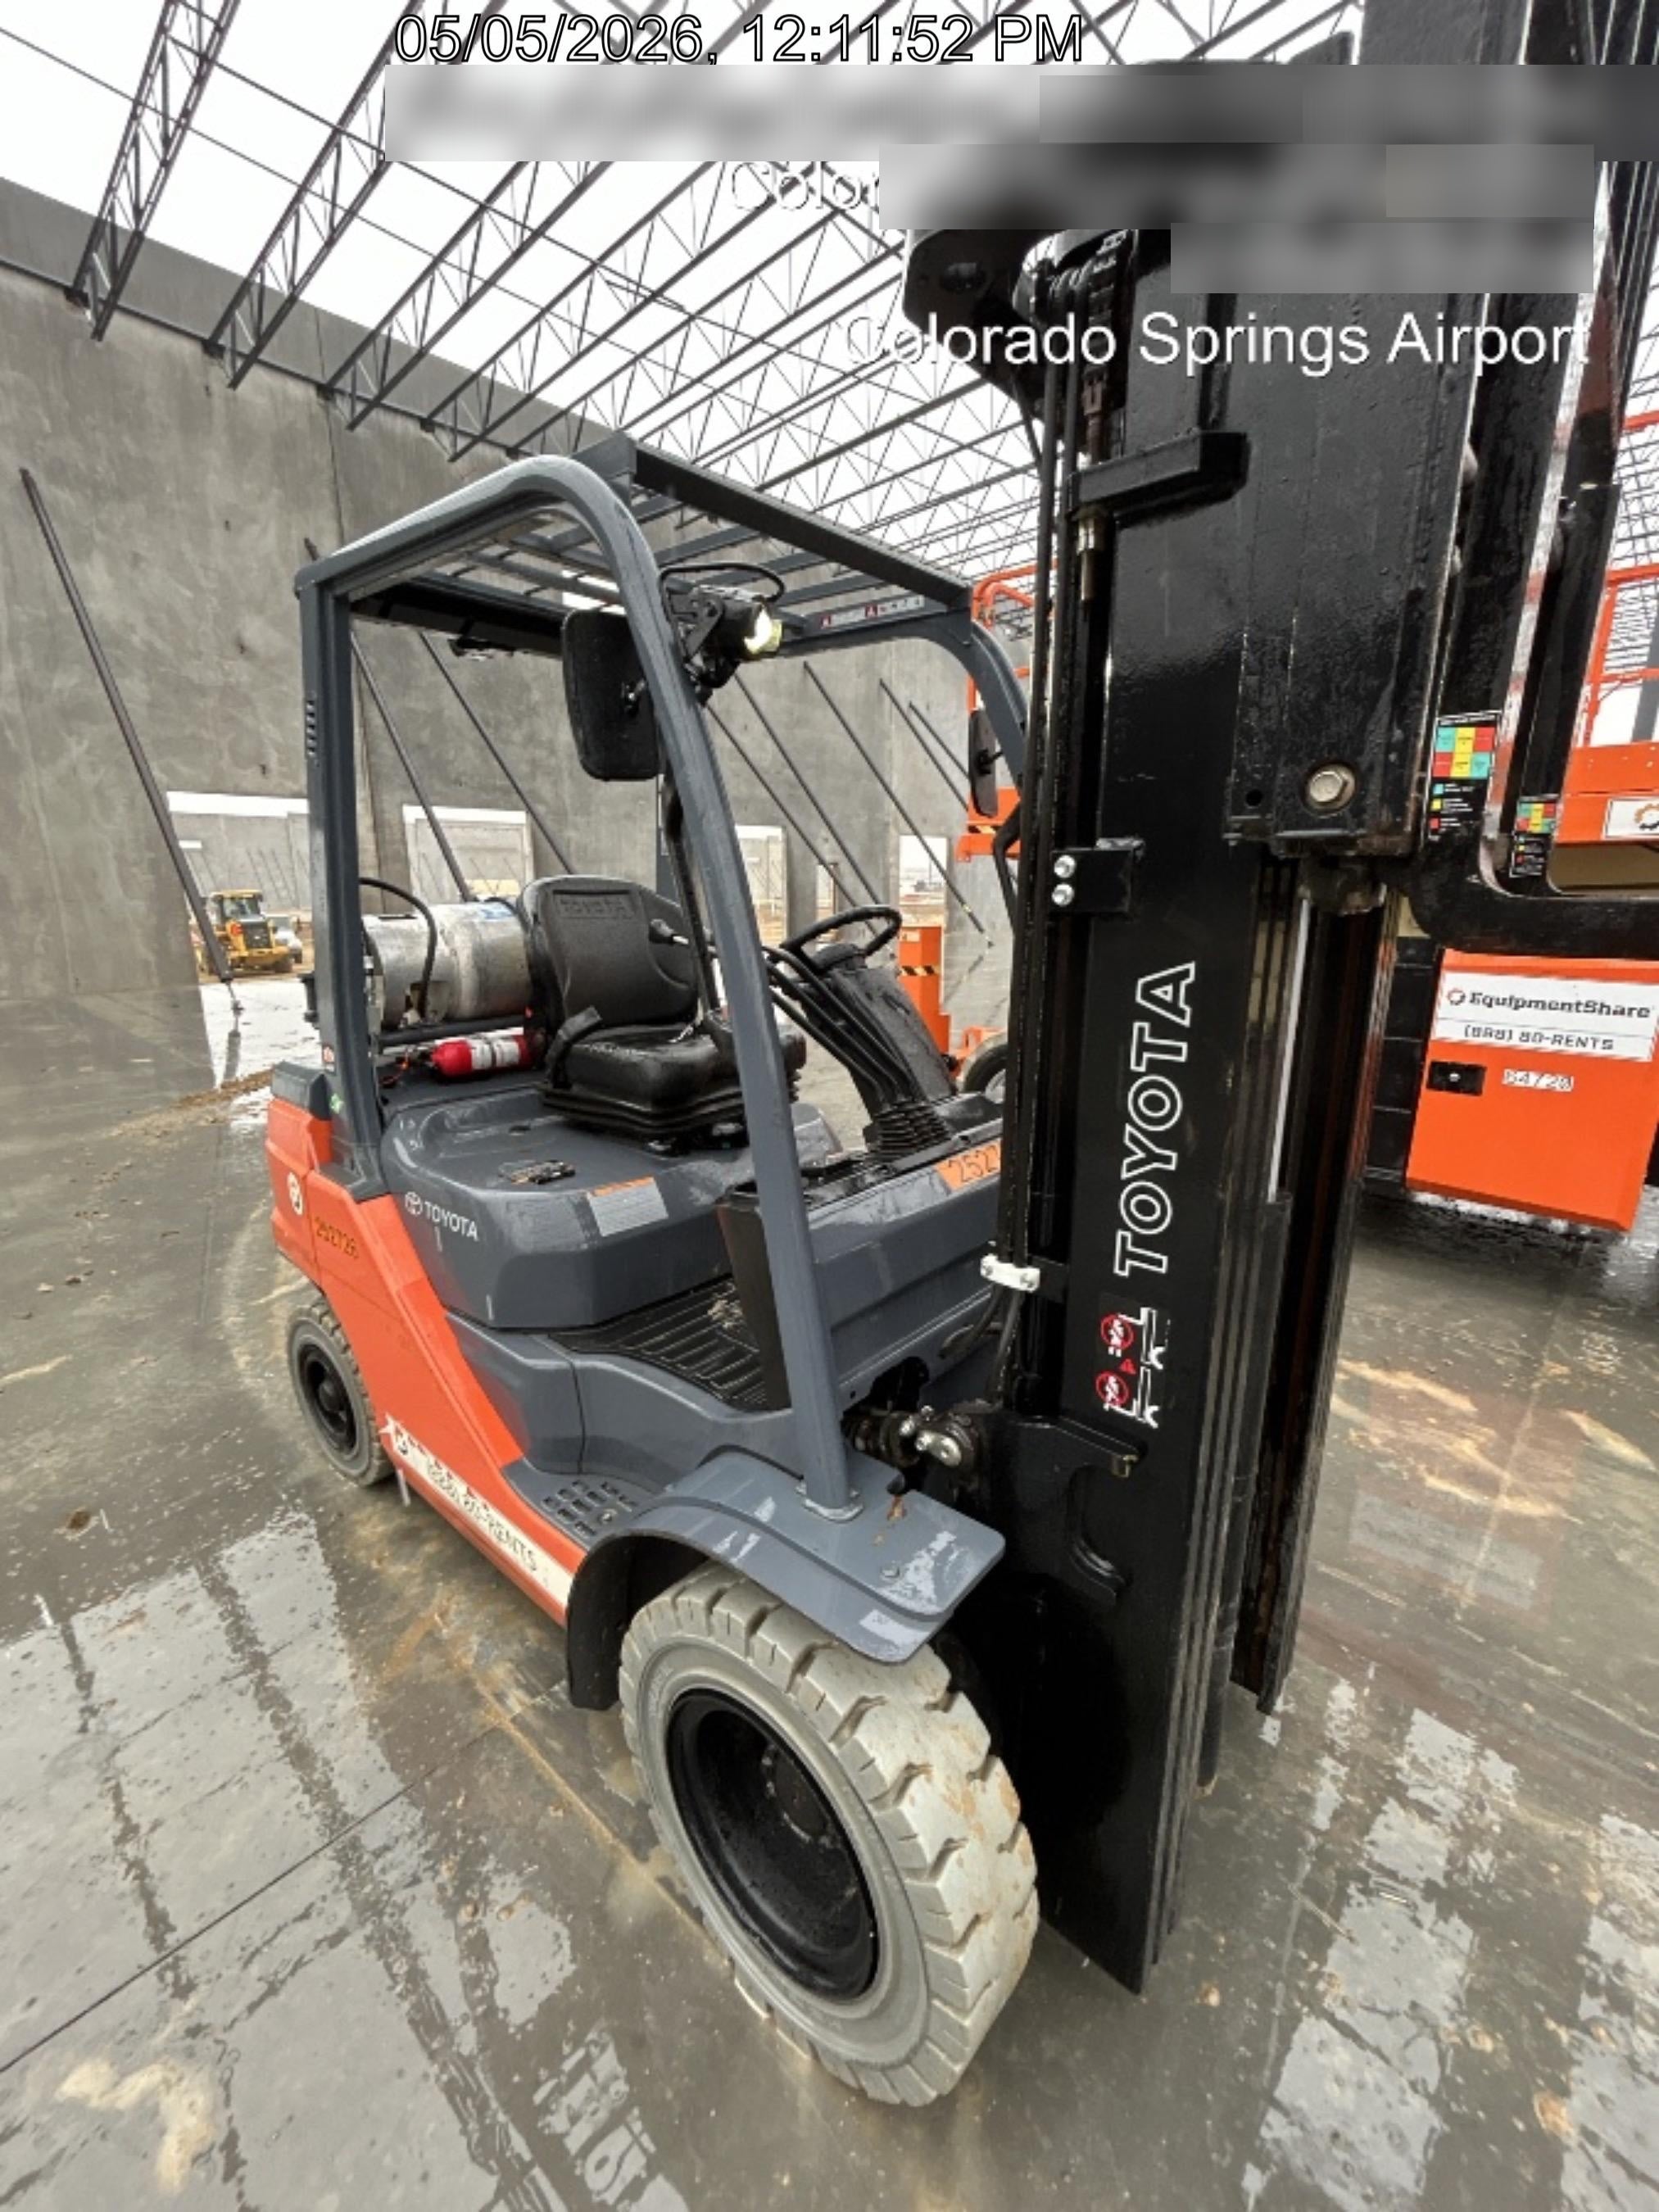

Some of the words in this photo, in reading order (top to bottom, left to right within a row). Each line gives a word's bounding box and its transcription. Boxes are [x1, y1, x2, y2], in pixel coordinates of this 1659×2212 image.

[1469, 991, 1651, 1019] EquipmentShare
[1113, 961, 1196, 1277] TOYOTA
[424, 1200, 479, 1242] TOYOTA
